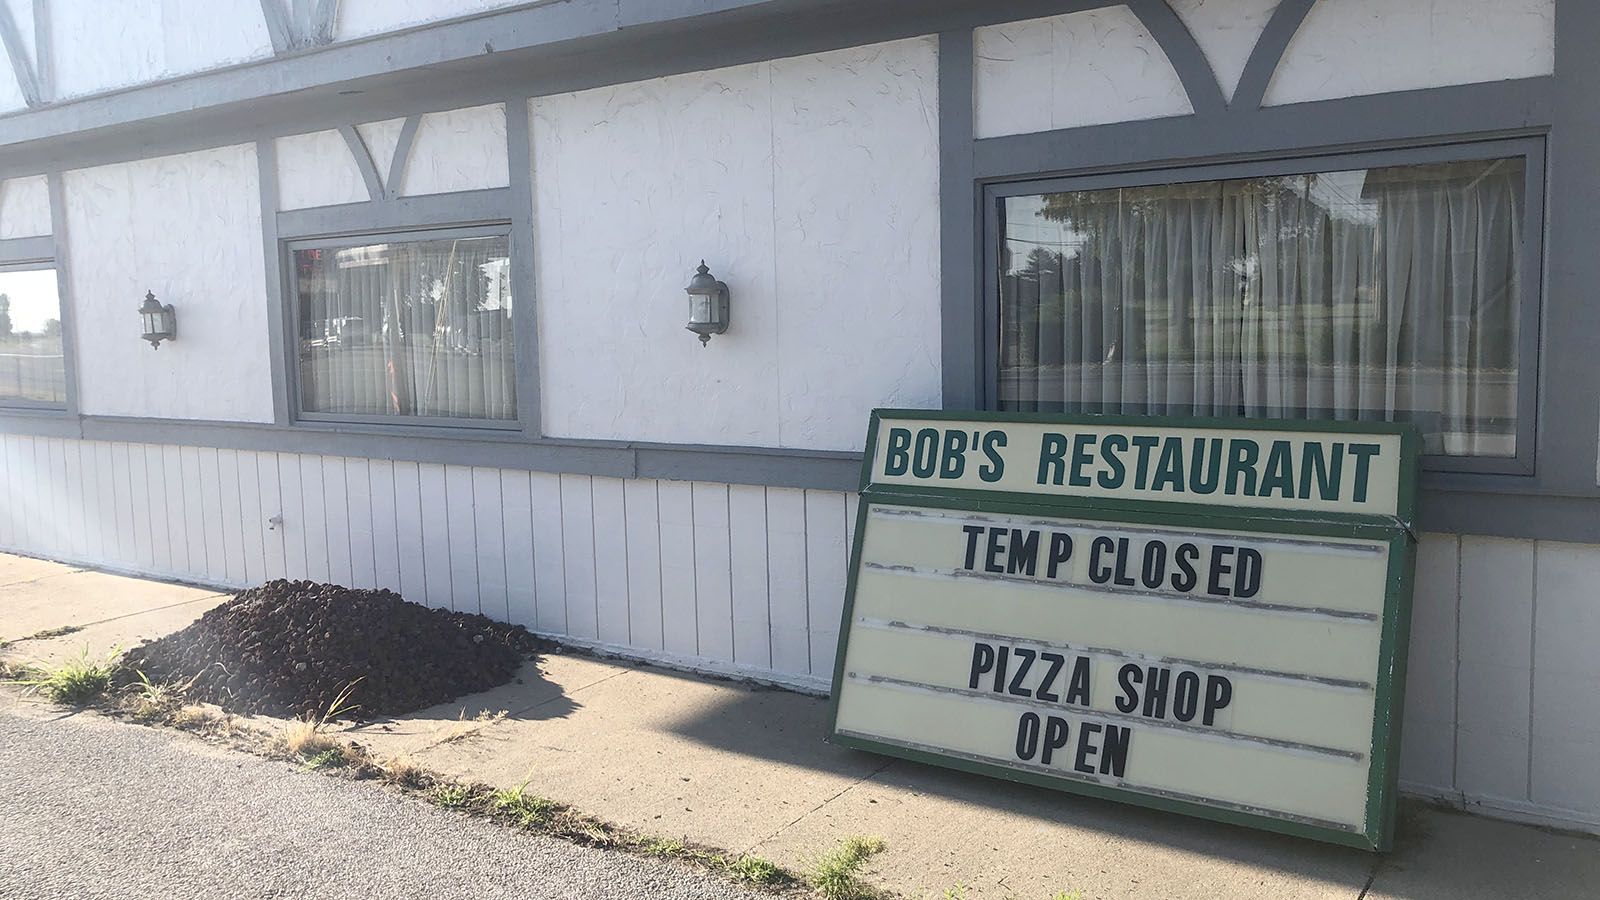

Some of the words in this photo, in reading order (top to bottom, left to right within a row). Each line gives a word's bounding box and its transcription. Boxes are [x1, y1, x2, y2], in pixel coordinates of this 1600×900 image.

[884, 427, 1008, 482] BOB'S
[1037, 433, 1380, 503] RESTAURANT
[963, 525, 1073, 579] TEMP
[1089, 536, 1263, 598] CLOSED
[969, 643, 1092, 706] PIZZA
[1115, 664, 1232, 726] SHOP
[1016, 712, 1131, 777] OPEN
